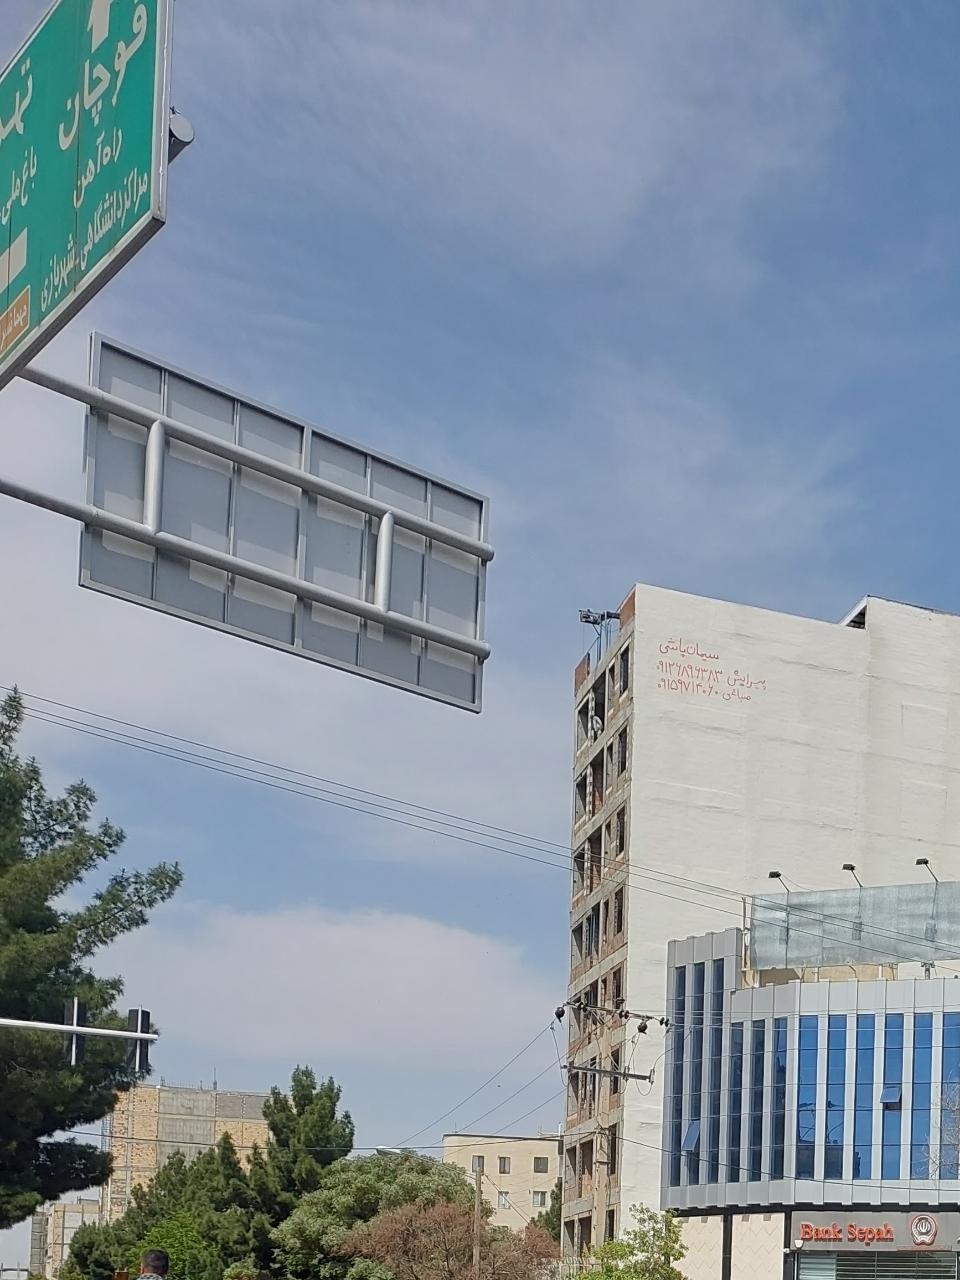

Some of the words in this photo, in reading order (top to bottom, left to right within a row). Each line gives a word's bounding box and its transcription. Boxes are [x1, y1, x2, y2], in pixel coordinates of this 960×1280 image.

[59, 0, 148, 150] قوچان
[21, 145, 37, 207] باغ
[121, 167, 148, 229] مراکز
[80, 189, 122, 271] دانشگاهی
[800, 1222, 843, 1242] Bank
[847, 1223, 895, 1247] Sepah
